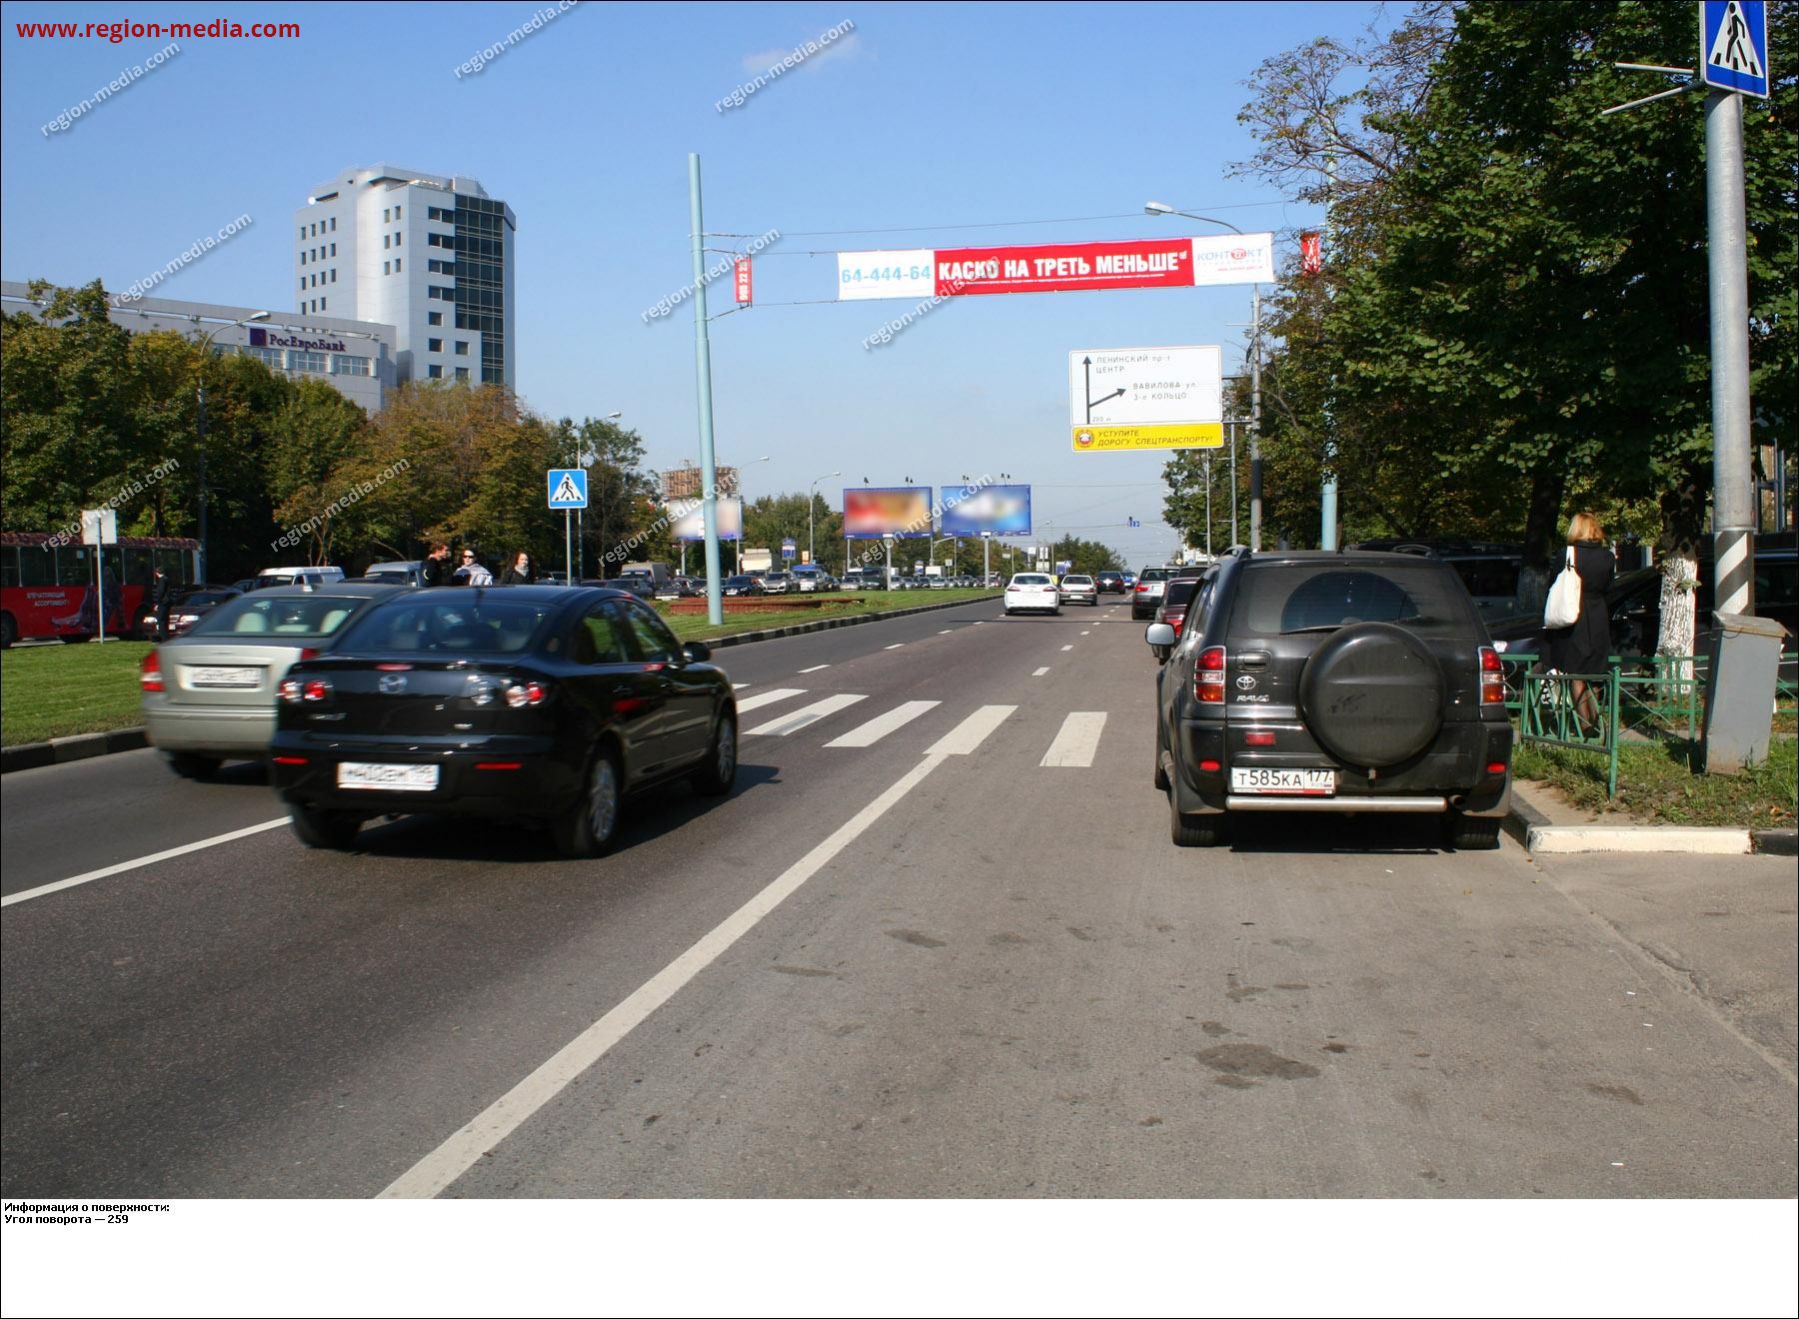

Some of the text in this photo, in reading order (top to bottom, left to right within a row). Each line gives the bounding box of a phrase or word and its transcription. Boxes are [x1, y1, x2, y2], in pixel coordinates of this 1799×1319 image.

[938, 259, 1000, 281] КАСКО
[1004, 258, 1030, 278] НА
[1035, 256, 1091, 277] ТРЕТЬ
[1095, 254, 1180, 275] МЕНЬШЕ
[841, 264, 931, 283] 64-444-64
[269, 334, 346, 352] РосЕвроБанк
[1095, 366, 1126, 375] ЦЕНТР
[1132, 381, 1182, 390] ВАВИЛОВА
[1151, 391, 1188, 400] КОЛЬЦО
[1097, 429, 1140, 438] УСТУПИТЕ
[1097, 438, 1131, 447] ДОРОГУ
[1306, 769, 1331, 783] 177
